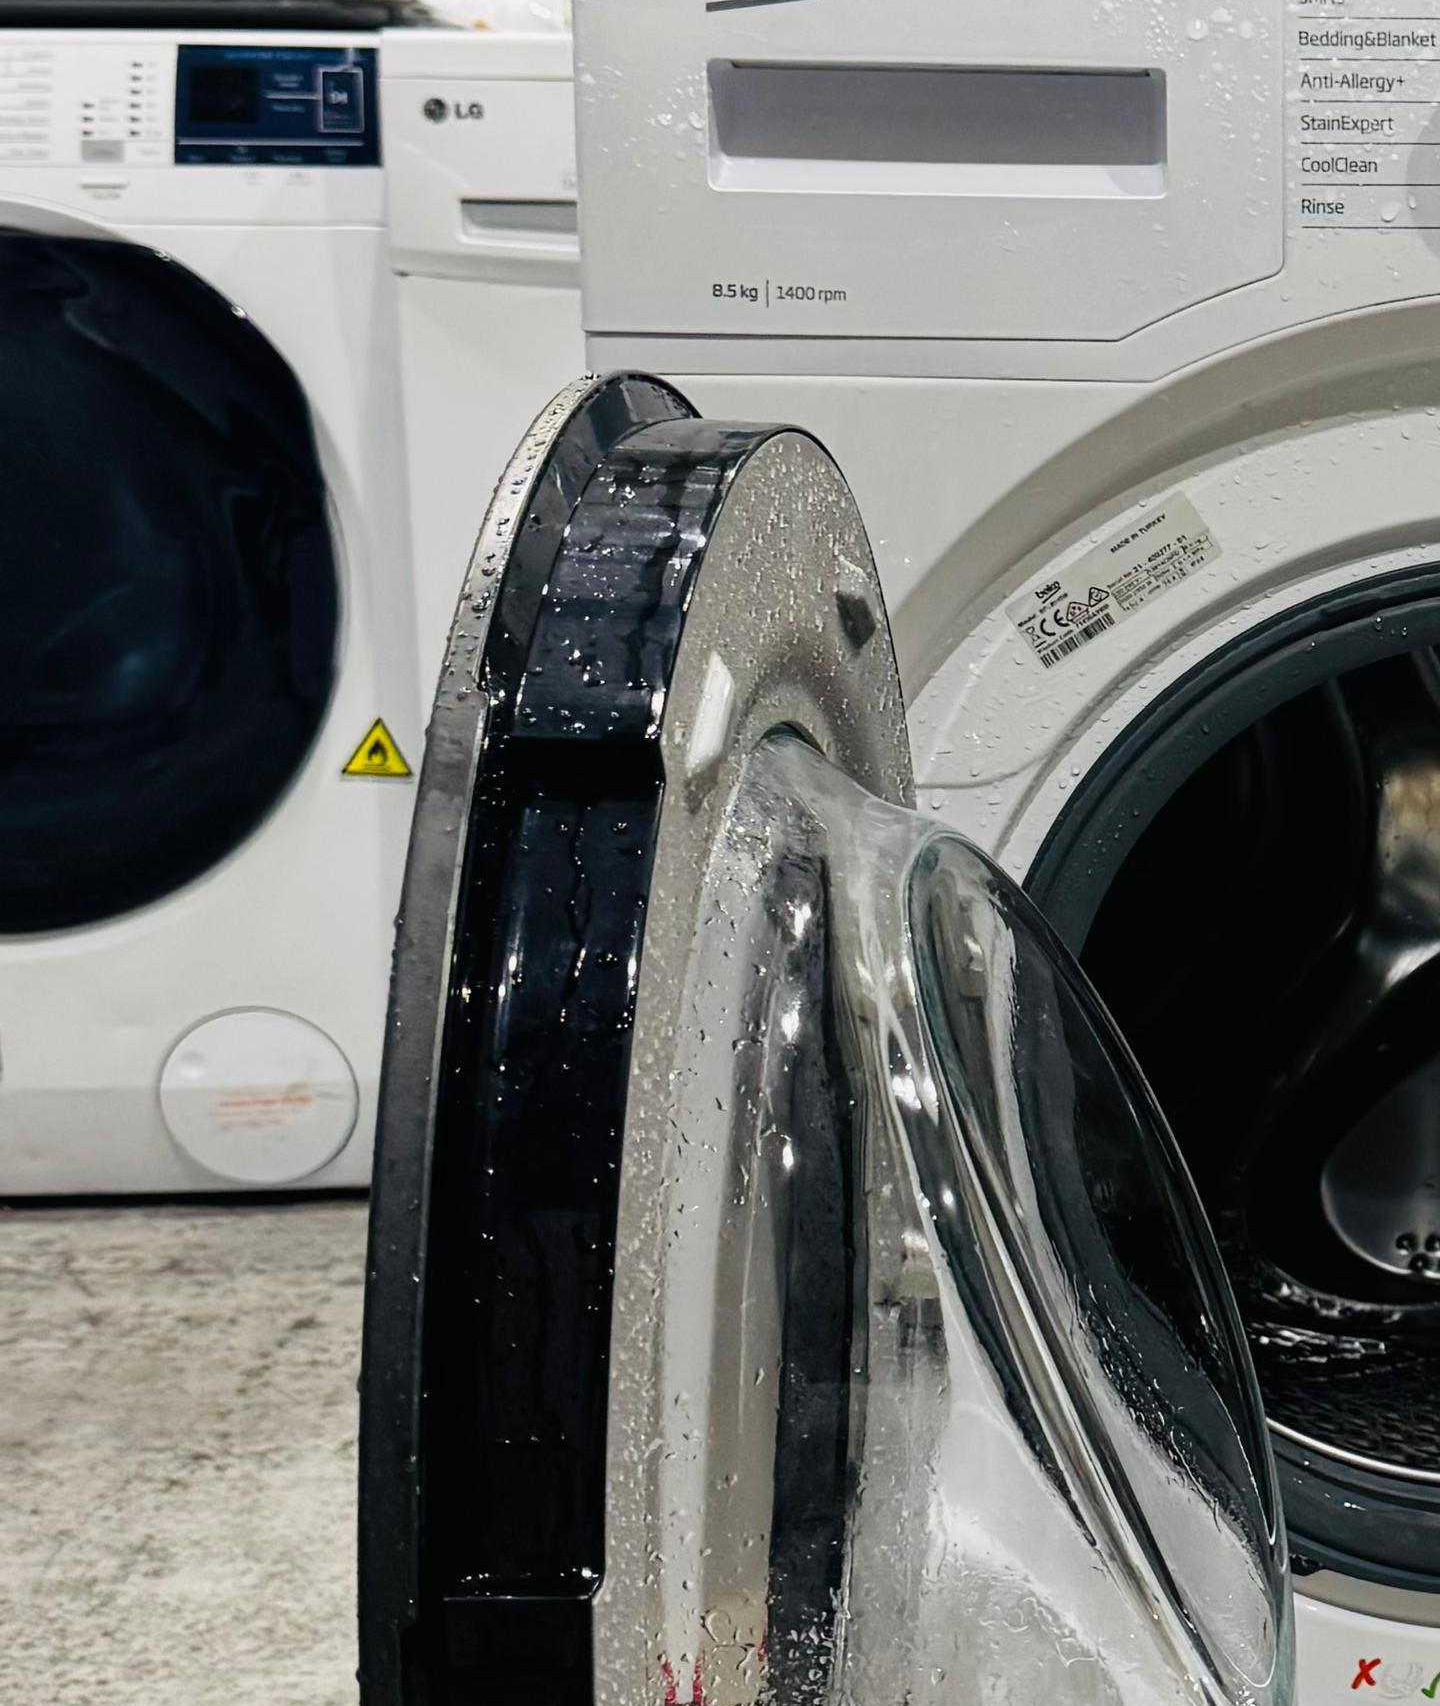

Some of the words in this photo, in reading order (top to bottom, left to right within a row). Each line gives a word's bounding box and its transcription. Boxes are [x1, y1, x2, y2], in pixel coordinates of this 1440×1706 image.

[1298, 31, 1437, 50] Bedding&Blanket
[1300, 72, 1405, 93] Anti-Allergy+
[454, 102, 485, 120] LG
[1300, 114, 1394, 134] StainExpert
[1301, 157, 1378, 173] CoolClean
[1301, 198, 1345, 215] Rinse
[712, 284, 737, 298] 8.5
[740, 284, 758, 302] kg
[776, 286, 815, 300] 1400
[818, 289, 846, 304] rpm
[1110, 538, 1130, 553] MADE
[1139, 513, 1166, 535] TURKEY
[1035, 580, 1061, 600] beko
